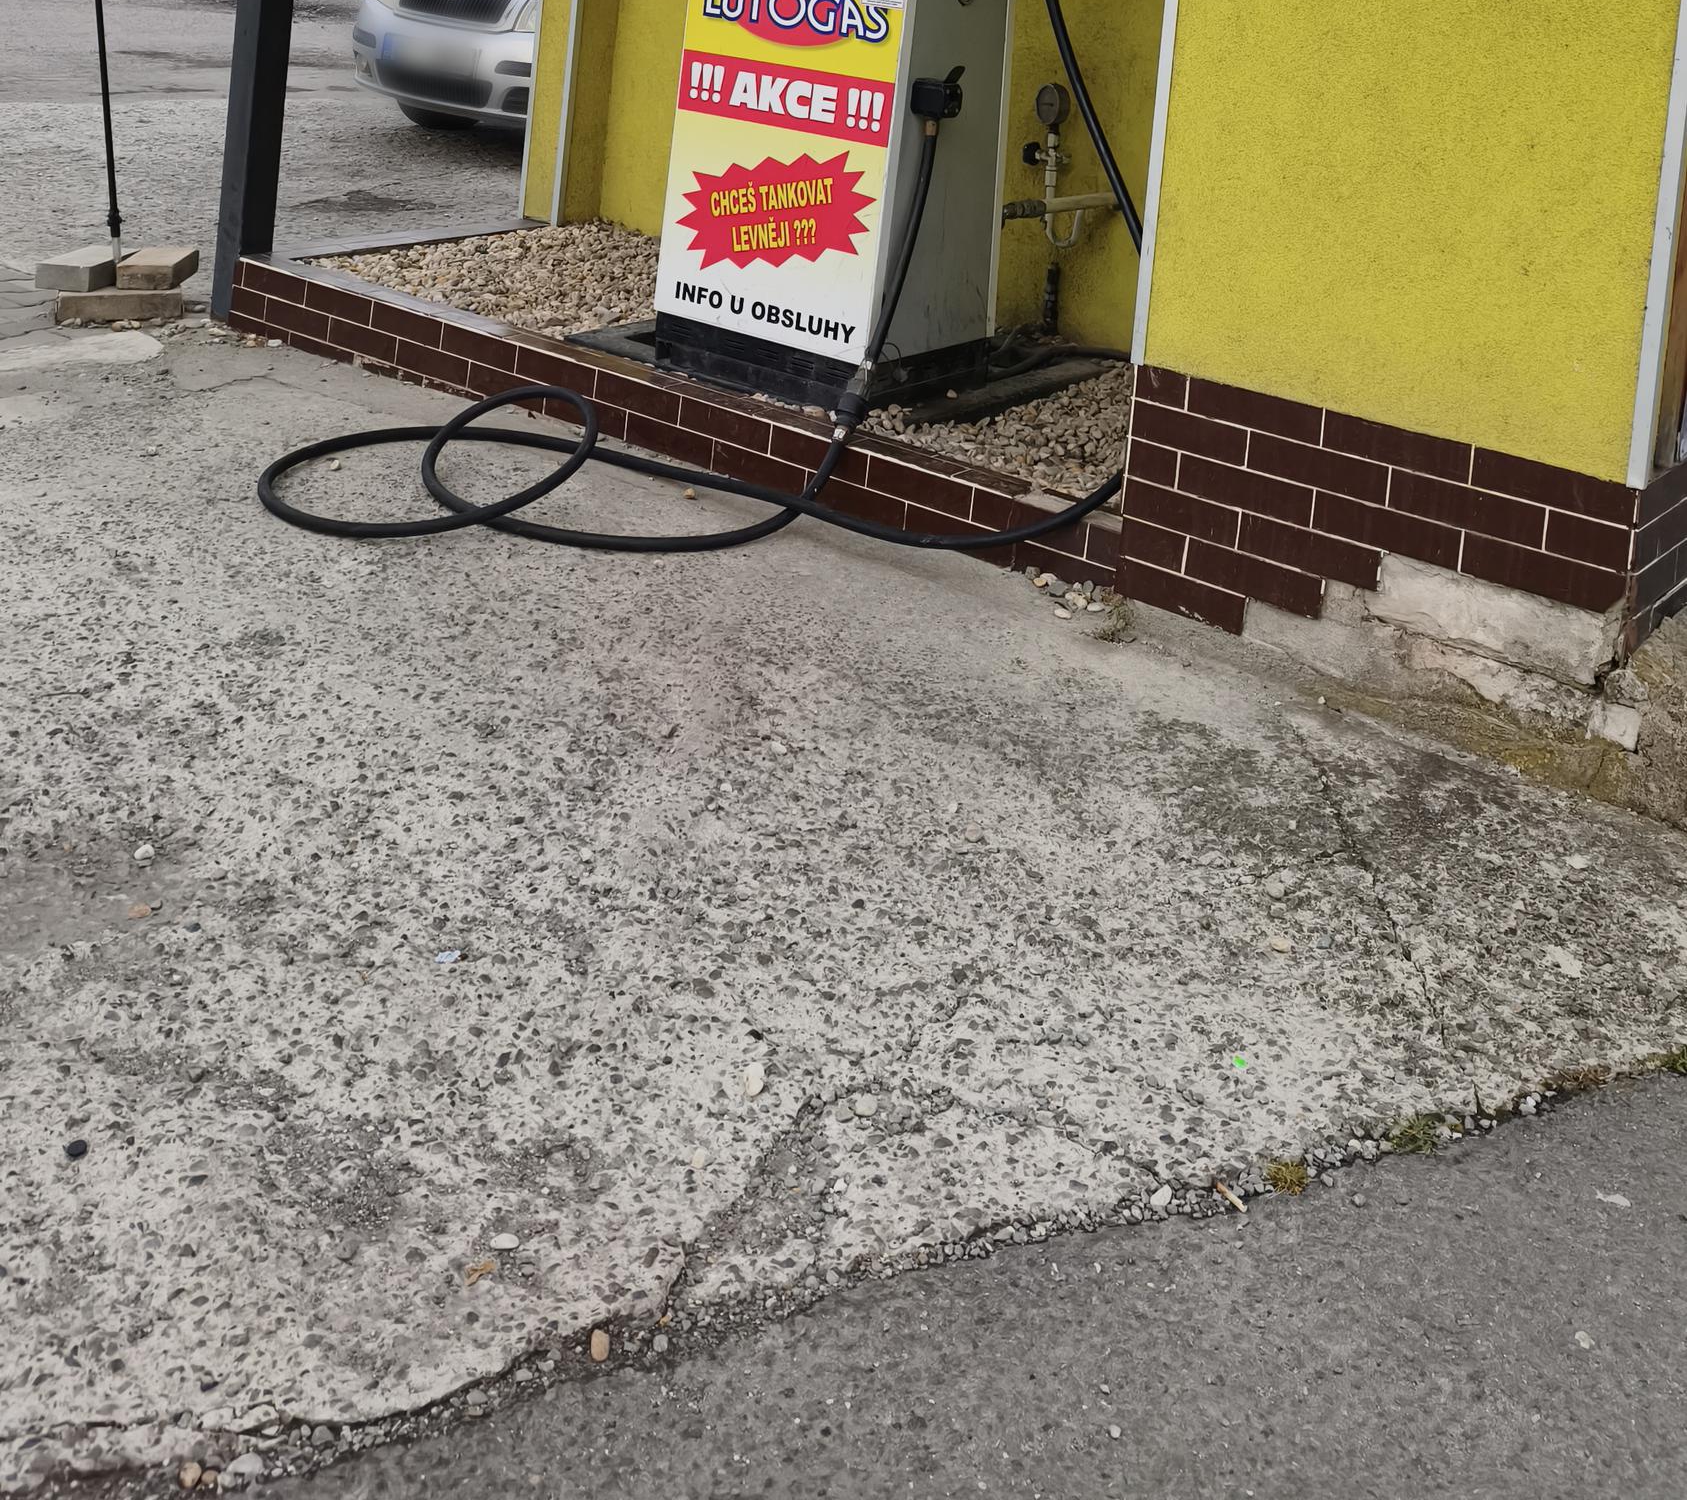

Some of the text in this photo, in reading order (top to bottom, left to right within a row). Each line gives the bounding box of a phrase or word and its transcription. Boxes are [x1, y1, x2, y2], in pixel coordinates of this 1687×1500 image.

[728, 70, 839, 124] AKCE
[710, 177, 833, 218] CHCEŠ TANKOVAT
[731, 216, 817, 253] LEVNĚJI ???
[675, 281, 856, 345] INFO U OBSLUHY
